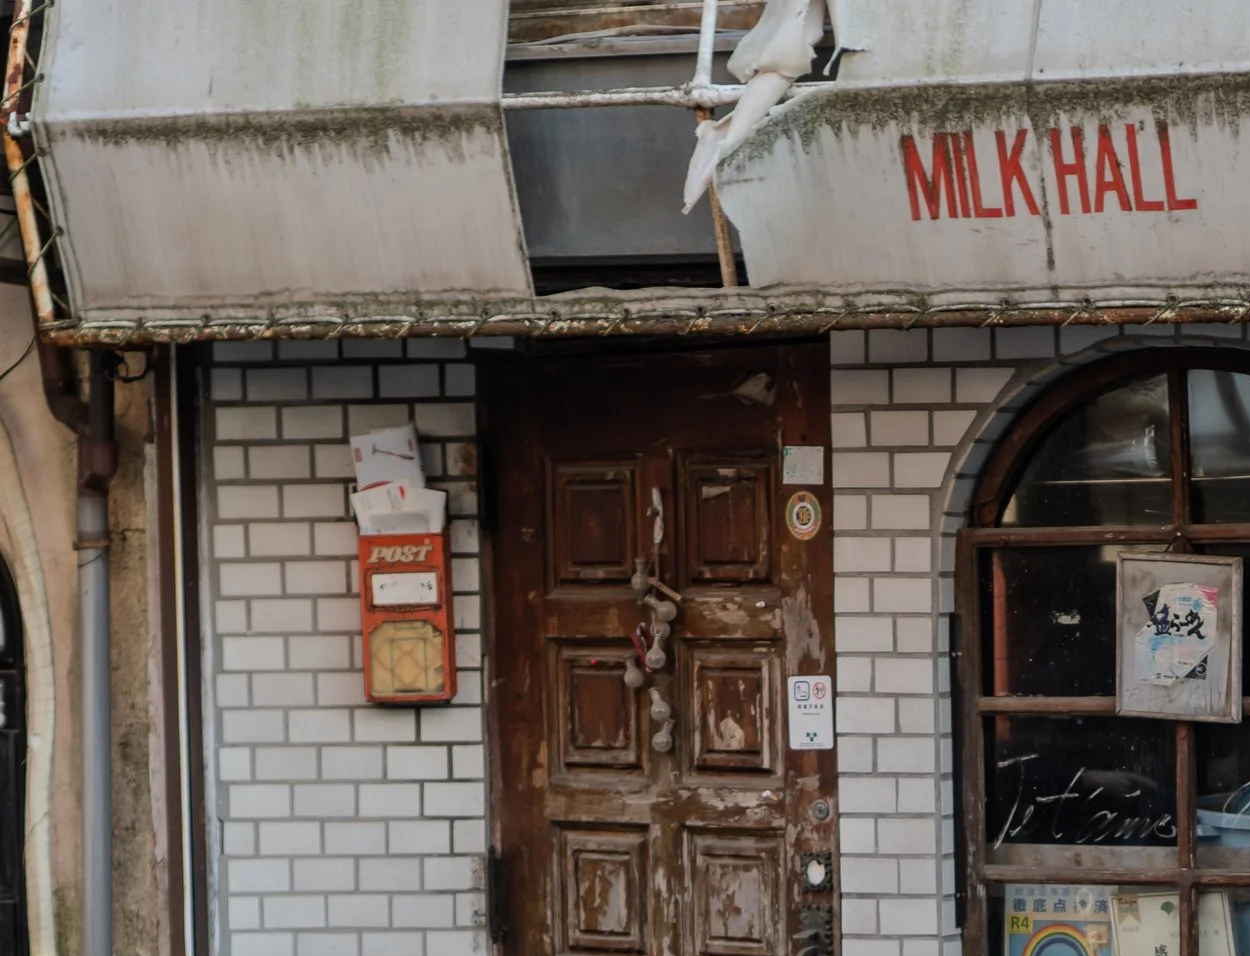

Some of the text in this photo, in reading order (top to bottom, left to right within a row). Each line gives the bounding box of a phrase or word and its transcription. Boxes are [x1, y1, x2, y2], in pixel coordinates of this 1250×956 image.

[900, 123, 1198, 221] MILK HALL
[367, 544, 433, 563] POST
[1010, 916, 1031, 930] R4
